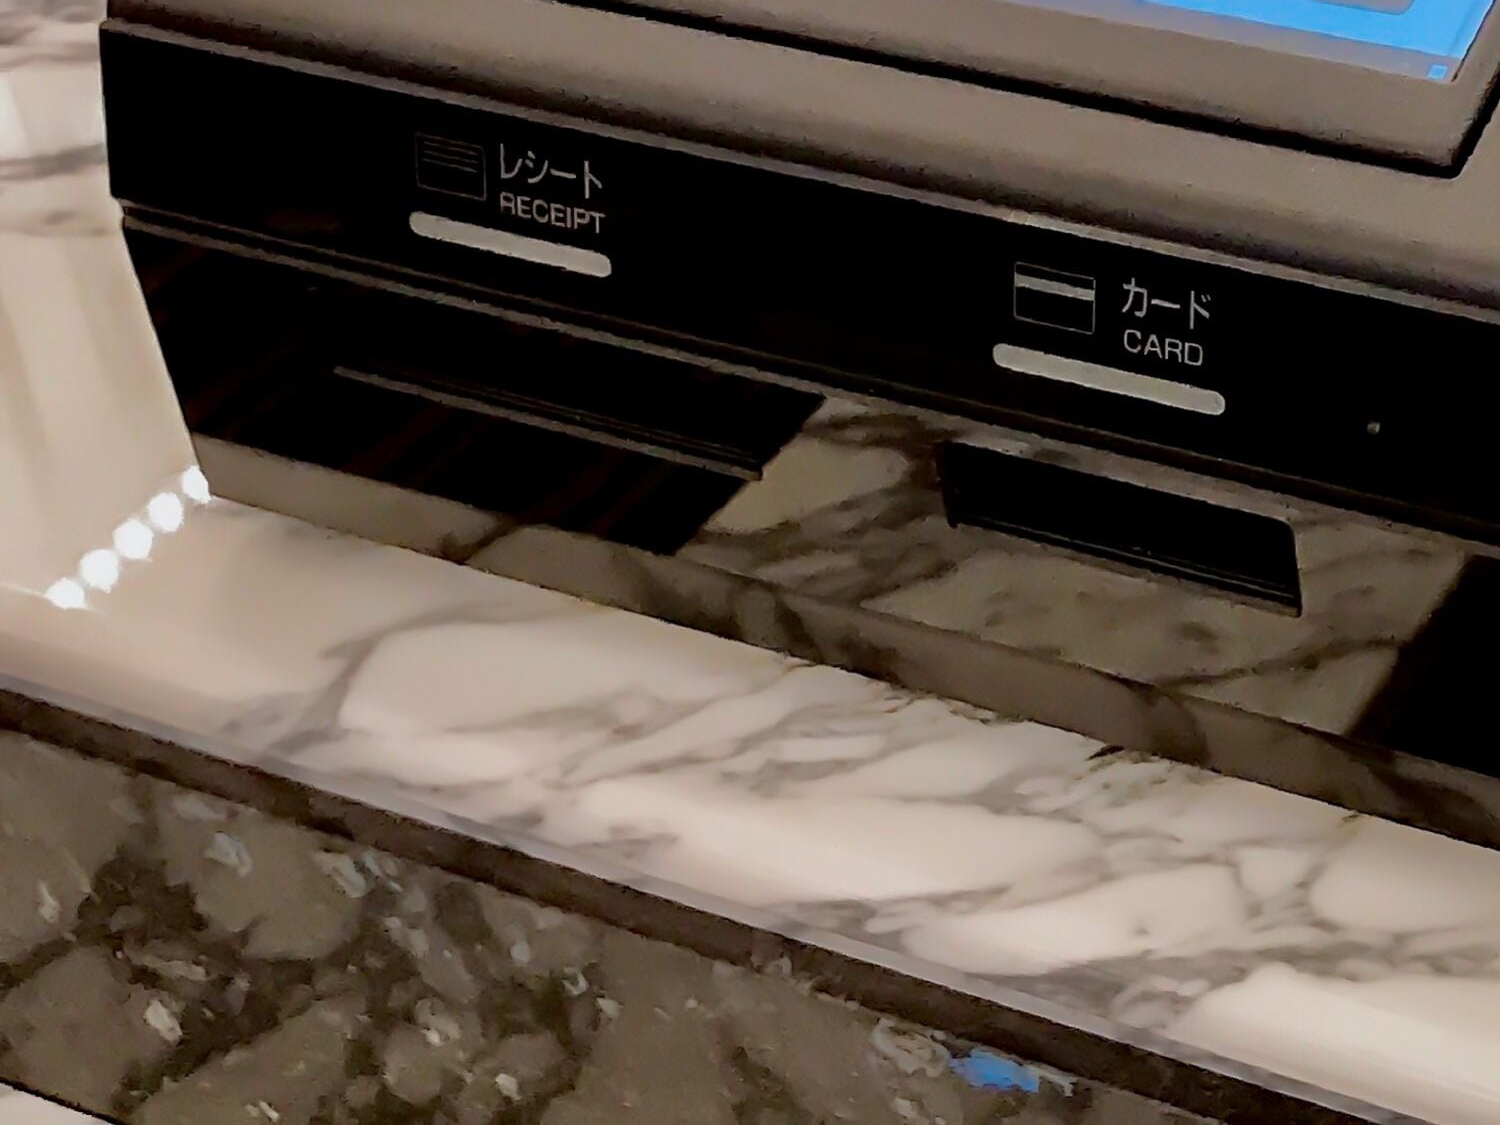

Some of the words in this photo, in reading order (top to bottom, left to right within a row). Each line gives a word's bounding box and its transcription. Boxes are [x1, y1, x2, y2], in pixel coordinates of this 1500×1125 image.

[499, 142, 603, 200] レシート
[499, 190, 607, 235] RECEIPT
[1121, 277, 1213, 330] カード
[1123, 328, 1204, 366] CARD
